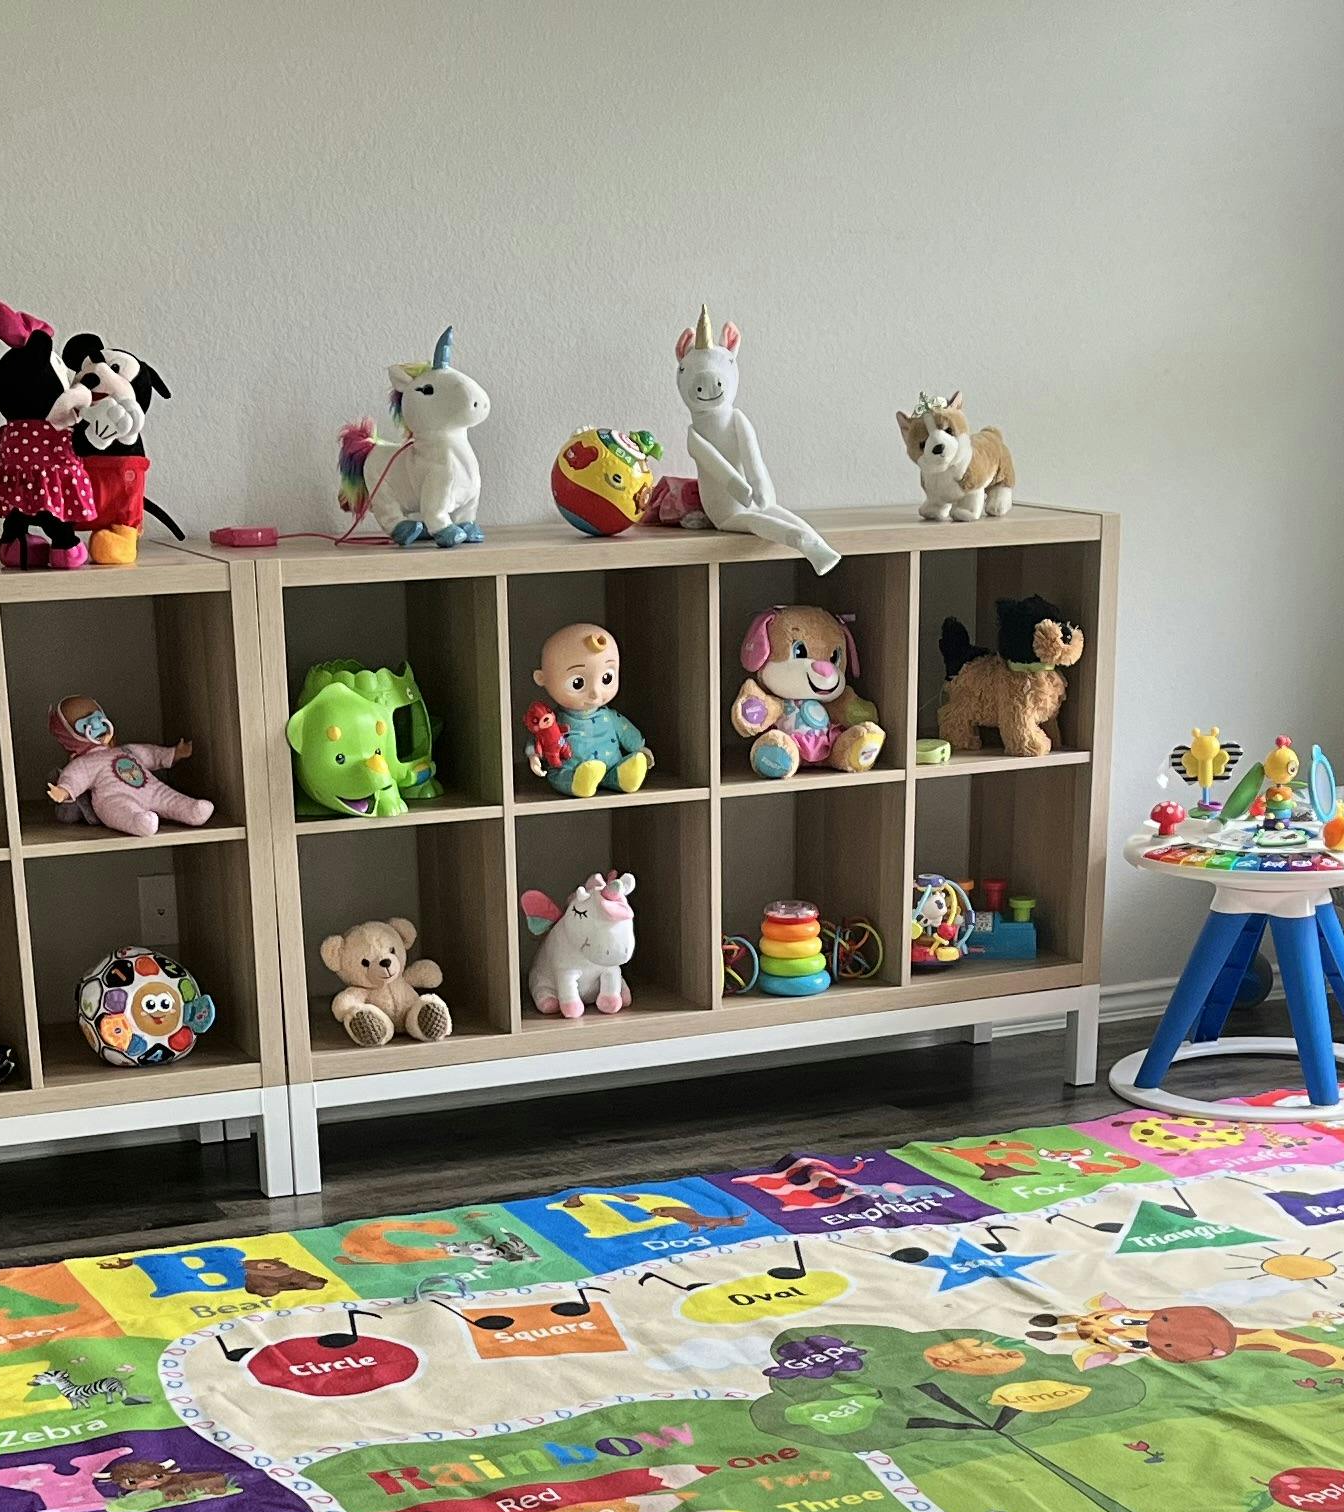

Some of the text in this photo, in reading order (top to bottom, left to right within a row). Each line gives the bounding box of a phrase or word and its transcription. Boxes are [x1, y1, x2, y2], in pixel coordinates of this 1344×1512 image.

[1207, 1149, 1298, 1171] Giraffe
[1011, 1181, 1074, 1200] Fox
[819, 1197, 944, 1227] Elephant
[641, 1235, 712, 1254] Dog
[1127, 1221, 1236, 1250] Triangle
[950, 1254, 1006, 1276] Star
[189, 1295, 274, 1320] Bear
[727, 1285, 808, 1308] Oval
[493, 1317, 599, 1347] Square
[288, 1351, 379, 1378] Circle
[783, 1342, 860, 1374] Grape
[997, 1386, 1086, 1405] Lemon
[811, 1396, 865, 1424] Pear
[366, 1422, 695, 1497] Rainbow
[726, 1446, 801, 1470] One
